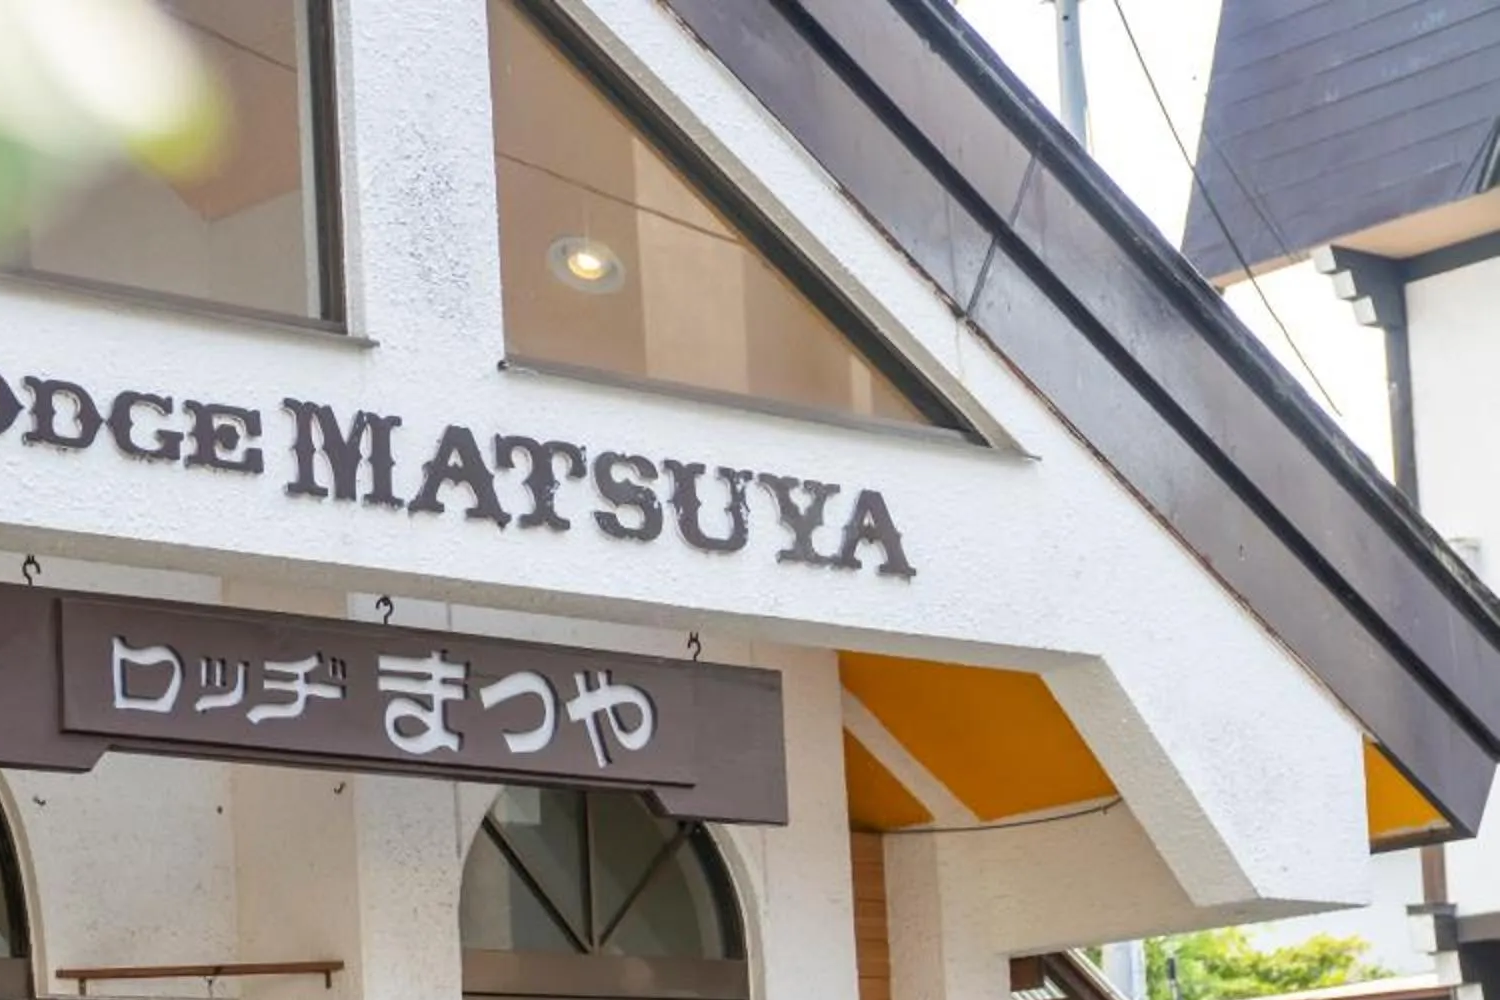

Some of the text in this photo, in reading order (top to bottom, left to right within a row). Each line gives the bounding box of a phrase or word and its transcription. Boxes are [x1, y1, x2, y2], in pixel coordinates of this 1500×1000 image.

[283, 397, 918, 579] MATSUYA
[377, 650, 656, 767] まつや
